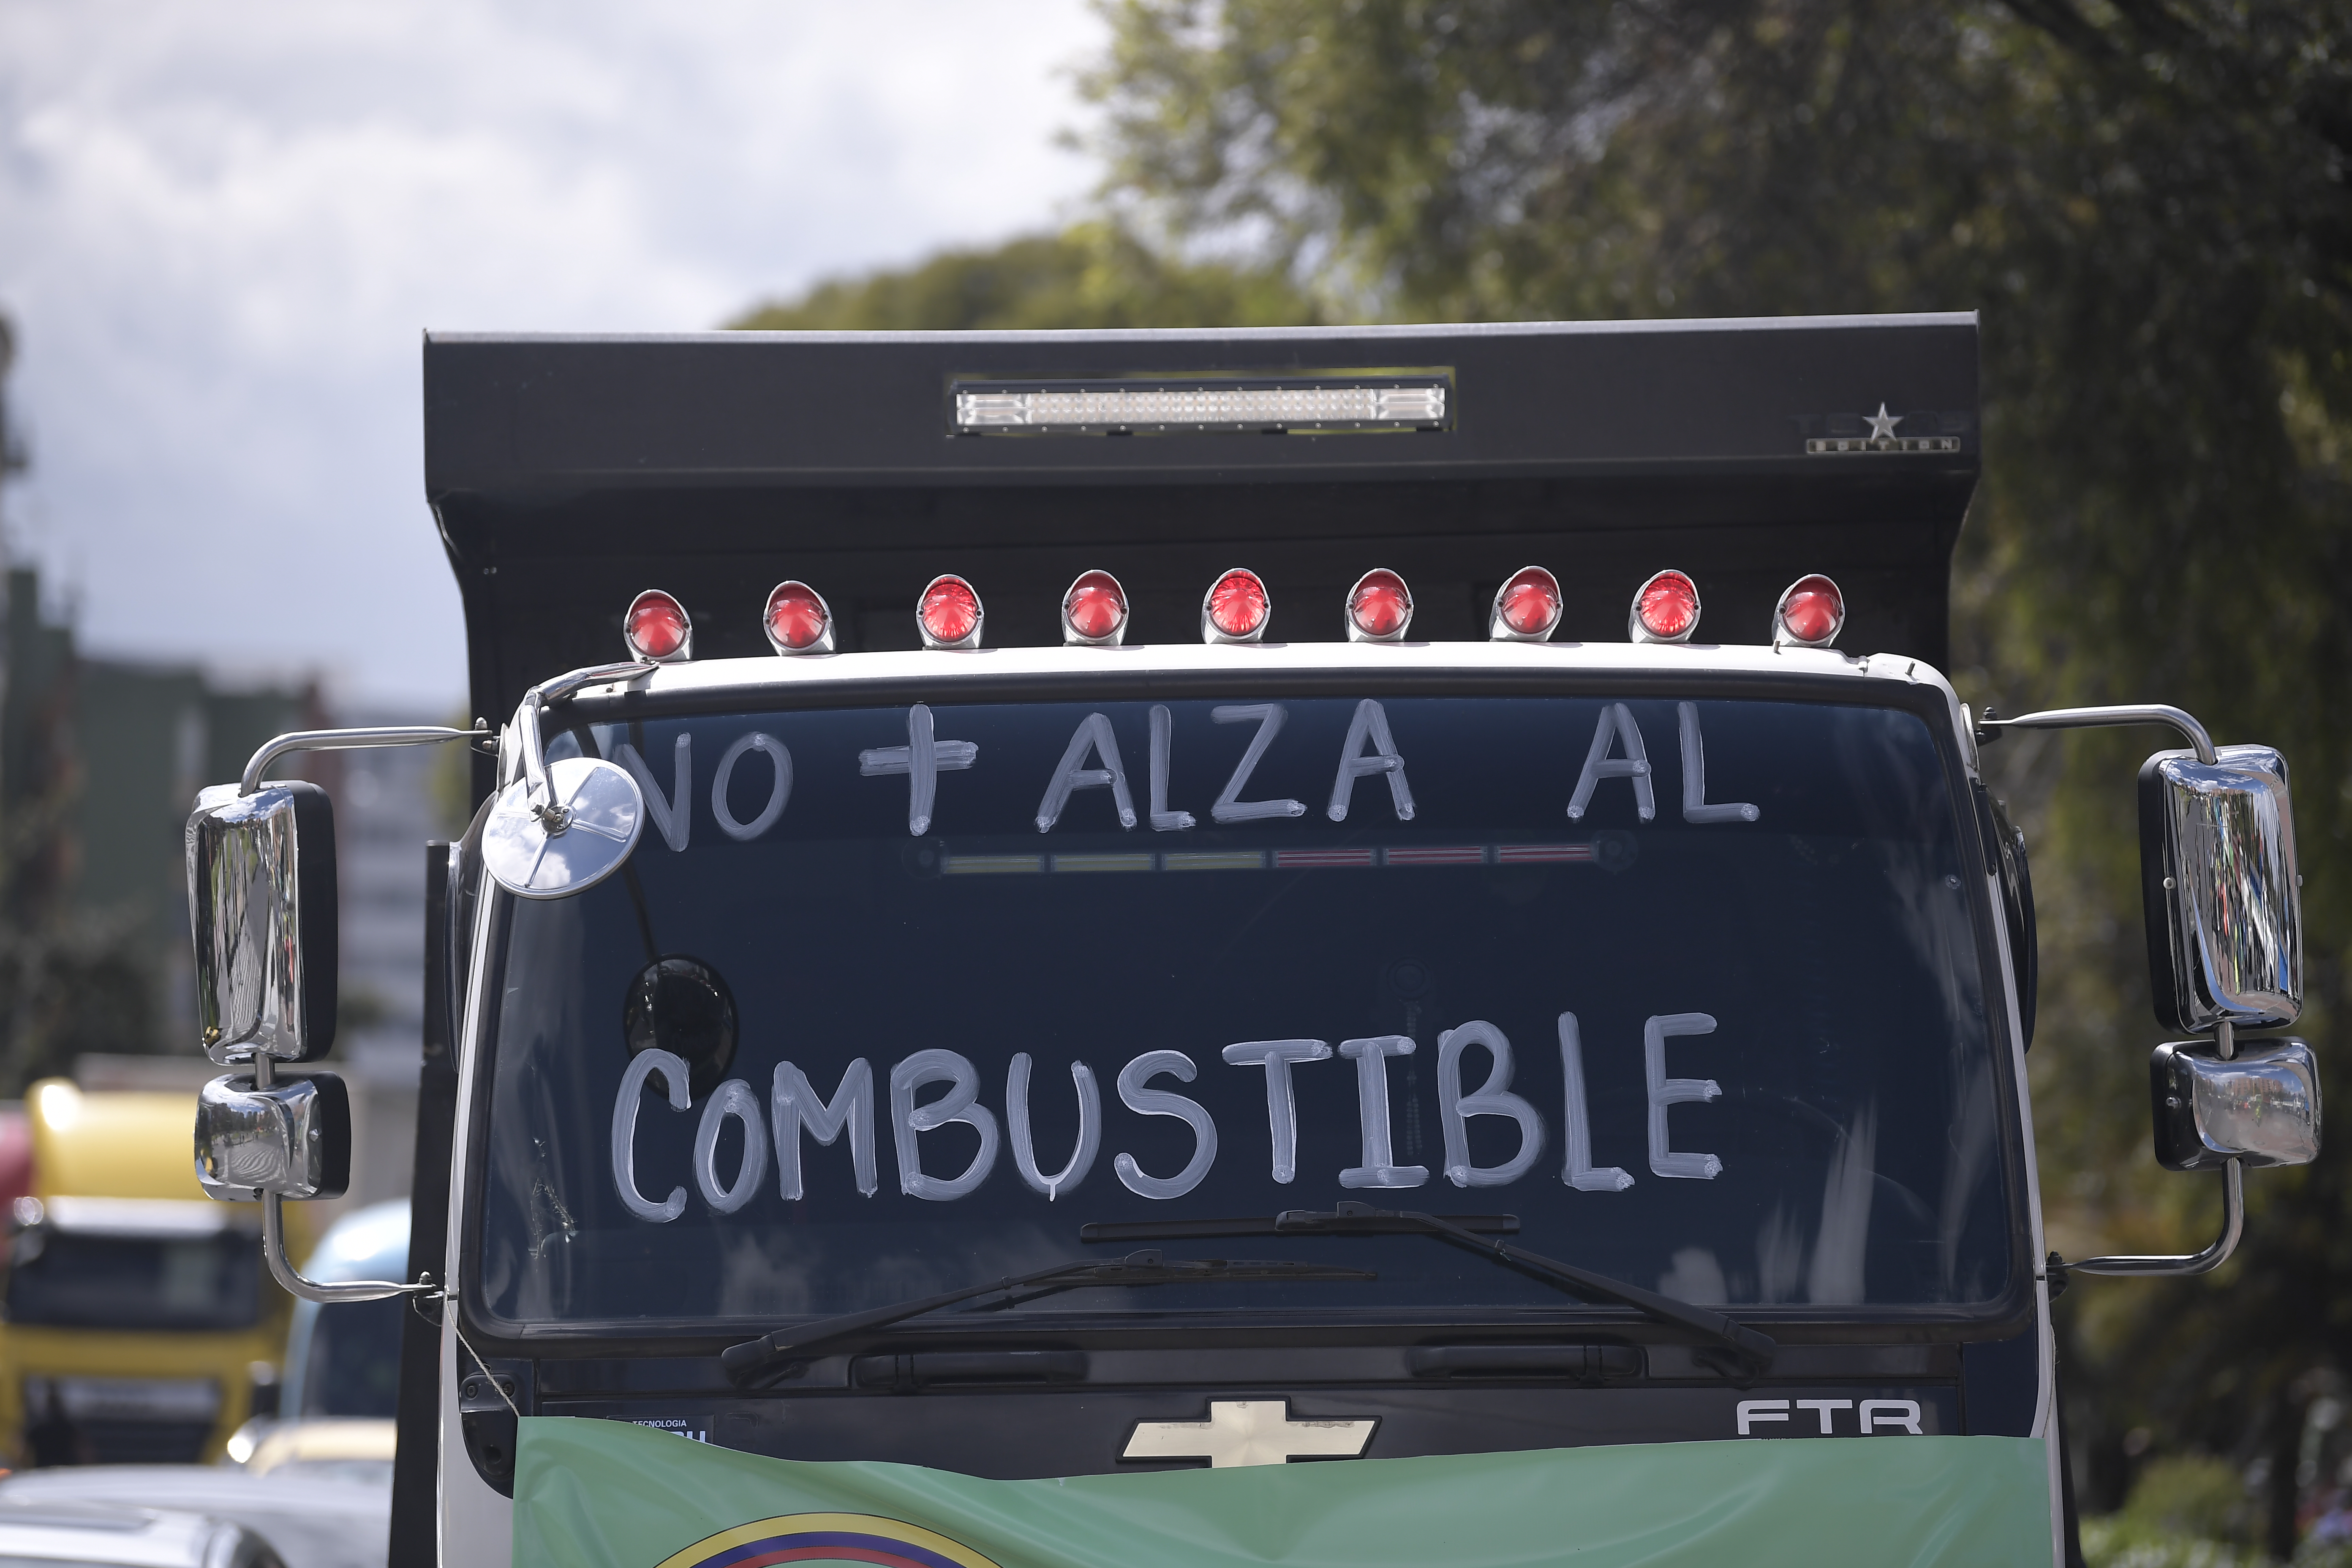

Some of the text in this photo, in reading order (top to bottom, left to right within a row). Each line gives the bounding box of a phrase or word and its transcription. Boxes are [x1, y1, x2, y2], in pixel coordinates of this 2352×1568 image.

[613, 698, 1761, 852] NO + ALZA AL
[611, 1011, 1723, 1223] COMBUSTIBLE
[1737, 1399, 1923, 1435] FTR
